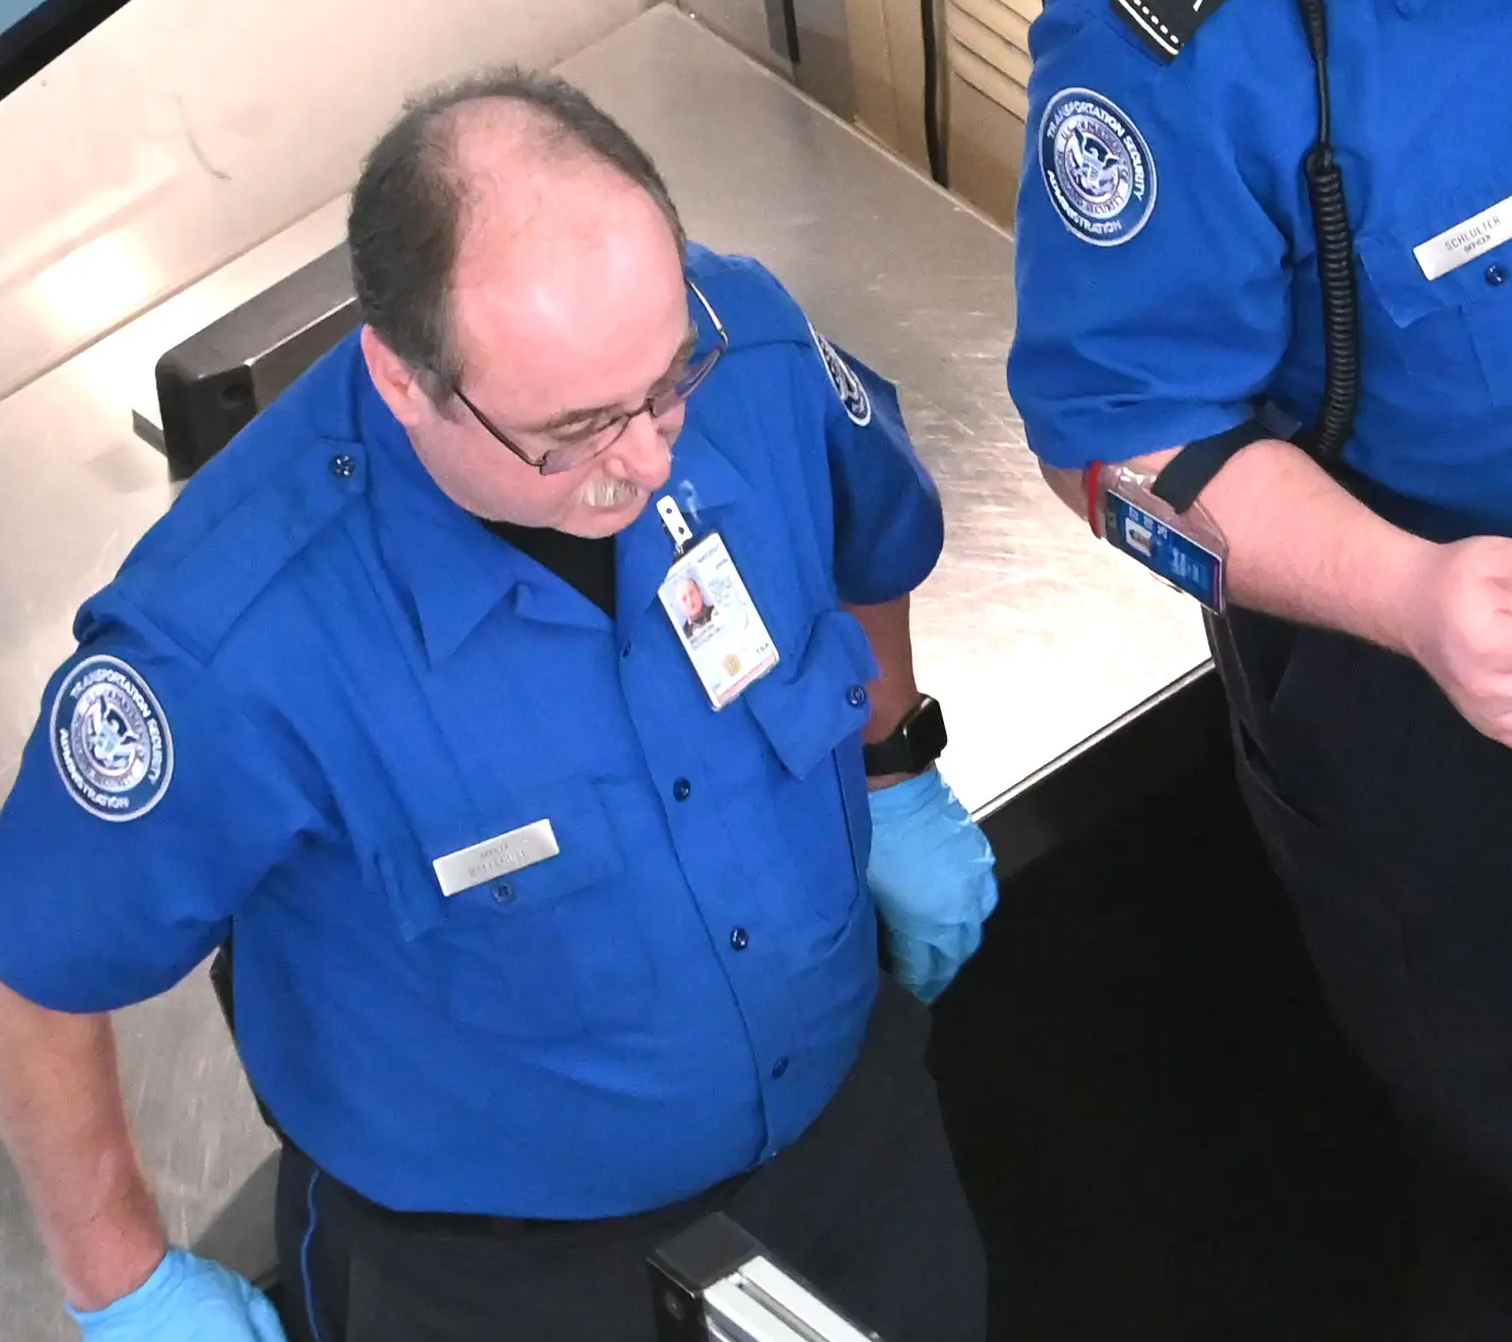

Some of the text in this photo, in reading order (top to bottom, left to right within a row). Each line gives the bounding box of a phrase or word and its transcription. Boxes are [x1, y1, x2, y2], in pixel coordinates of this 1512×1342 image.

[1046, 100, 1127, 139] TRANSPORTATION
[1123, 134, 1146, 202] SECURITY
[1046, 169, 1123, 235] ADMINISTRATION
